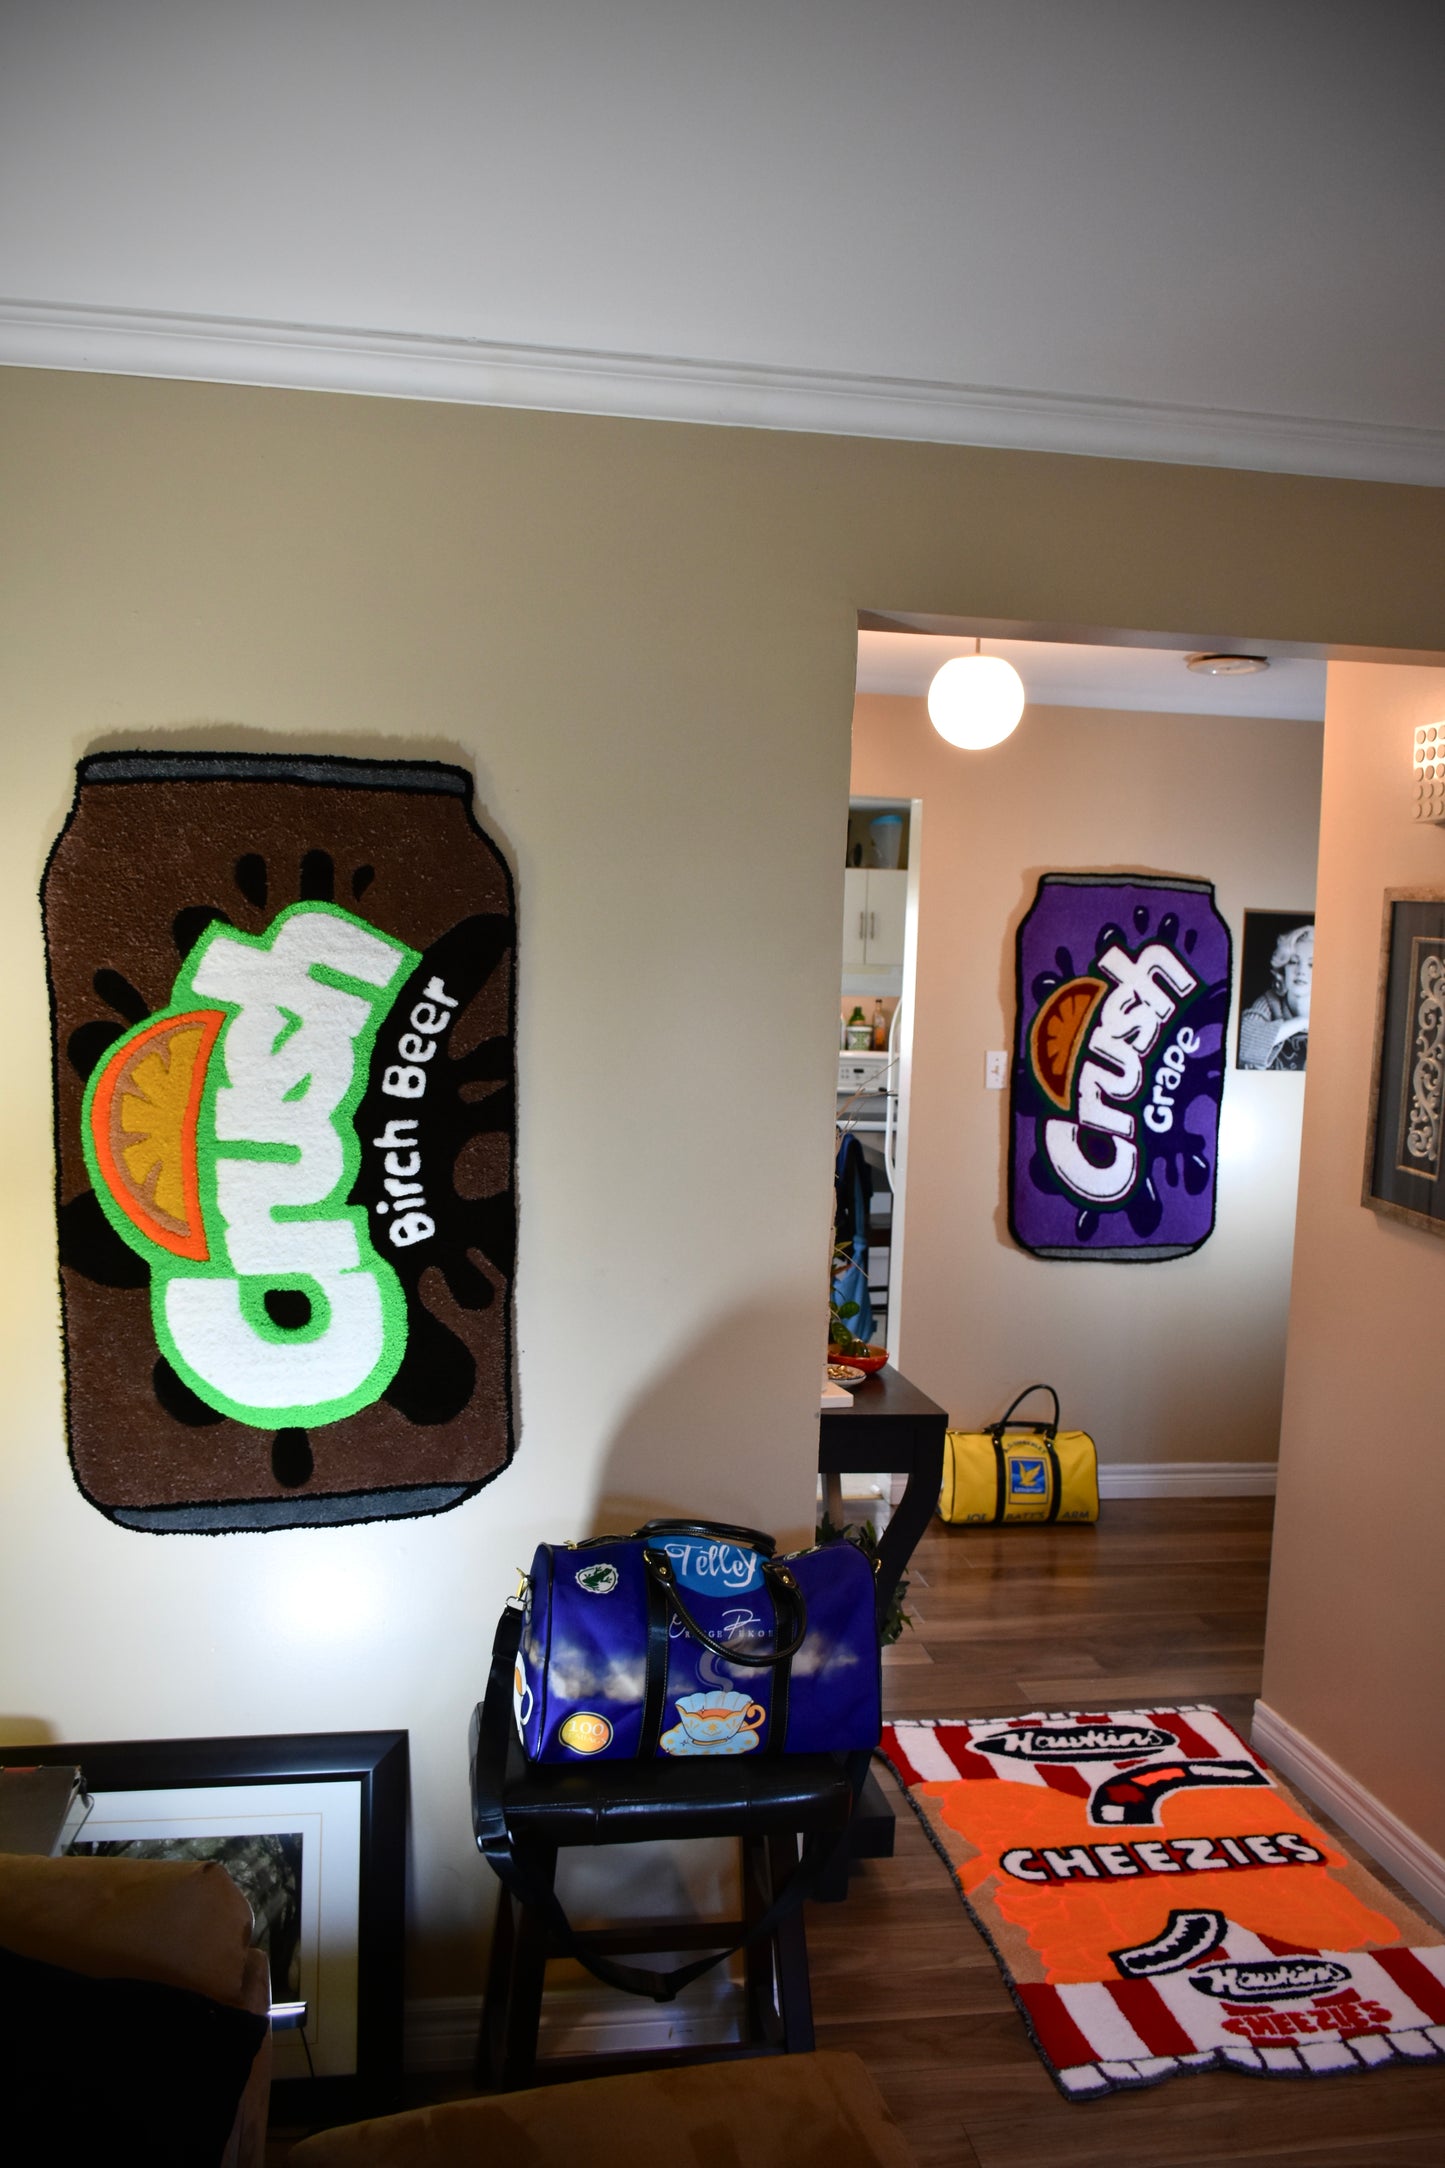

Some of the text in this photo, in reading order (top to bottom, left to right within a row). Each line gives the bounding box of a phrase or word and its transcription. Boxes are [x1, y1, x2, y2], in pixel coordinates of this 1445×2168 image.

[1045, 943, 1198, 1202] Crush
[1142, 1026, 1201, 1134] Grape
[372, 975, 459, 1247] Birch Beer
[164, 911, 404, 1408] Crush
[568, 1720, 605, 1737] 100
[1003, 1728, 1165, 1754] Hawkins
[1001, 1833, 1322, 1881] CHEEZIES
[1210, 1963, 1347, 1993] Hawkins
[1220, 1999, 1393, 2038] CHEEZIES
